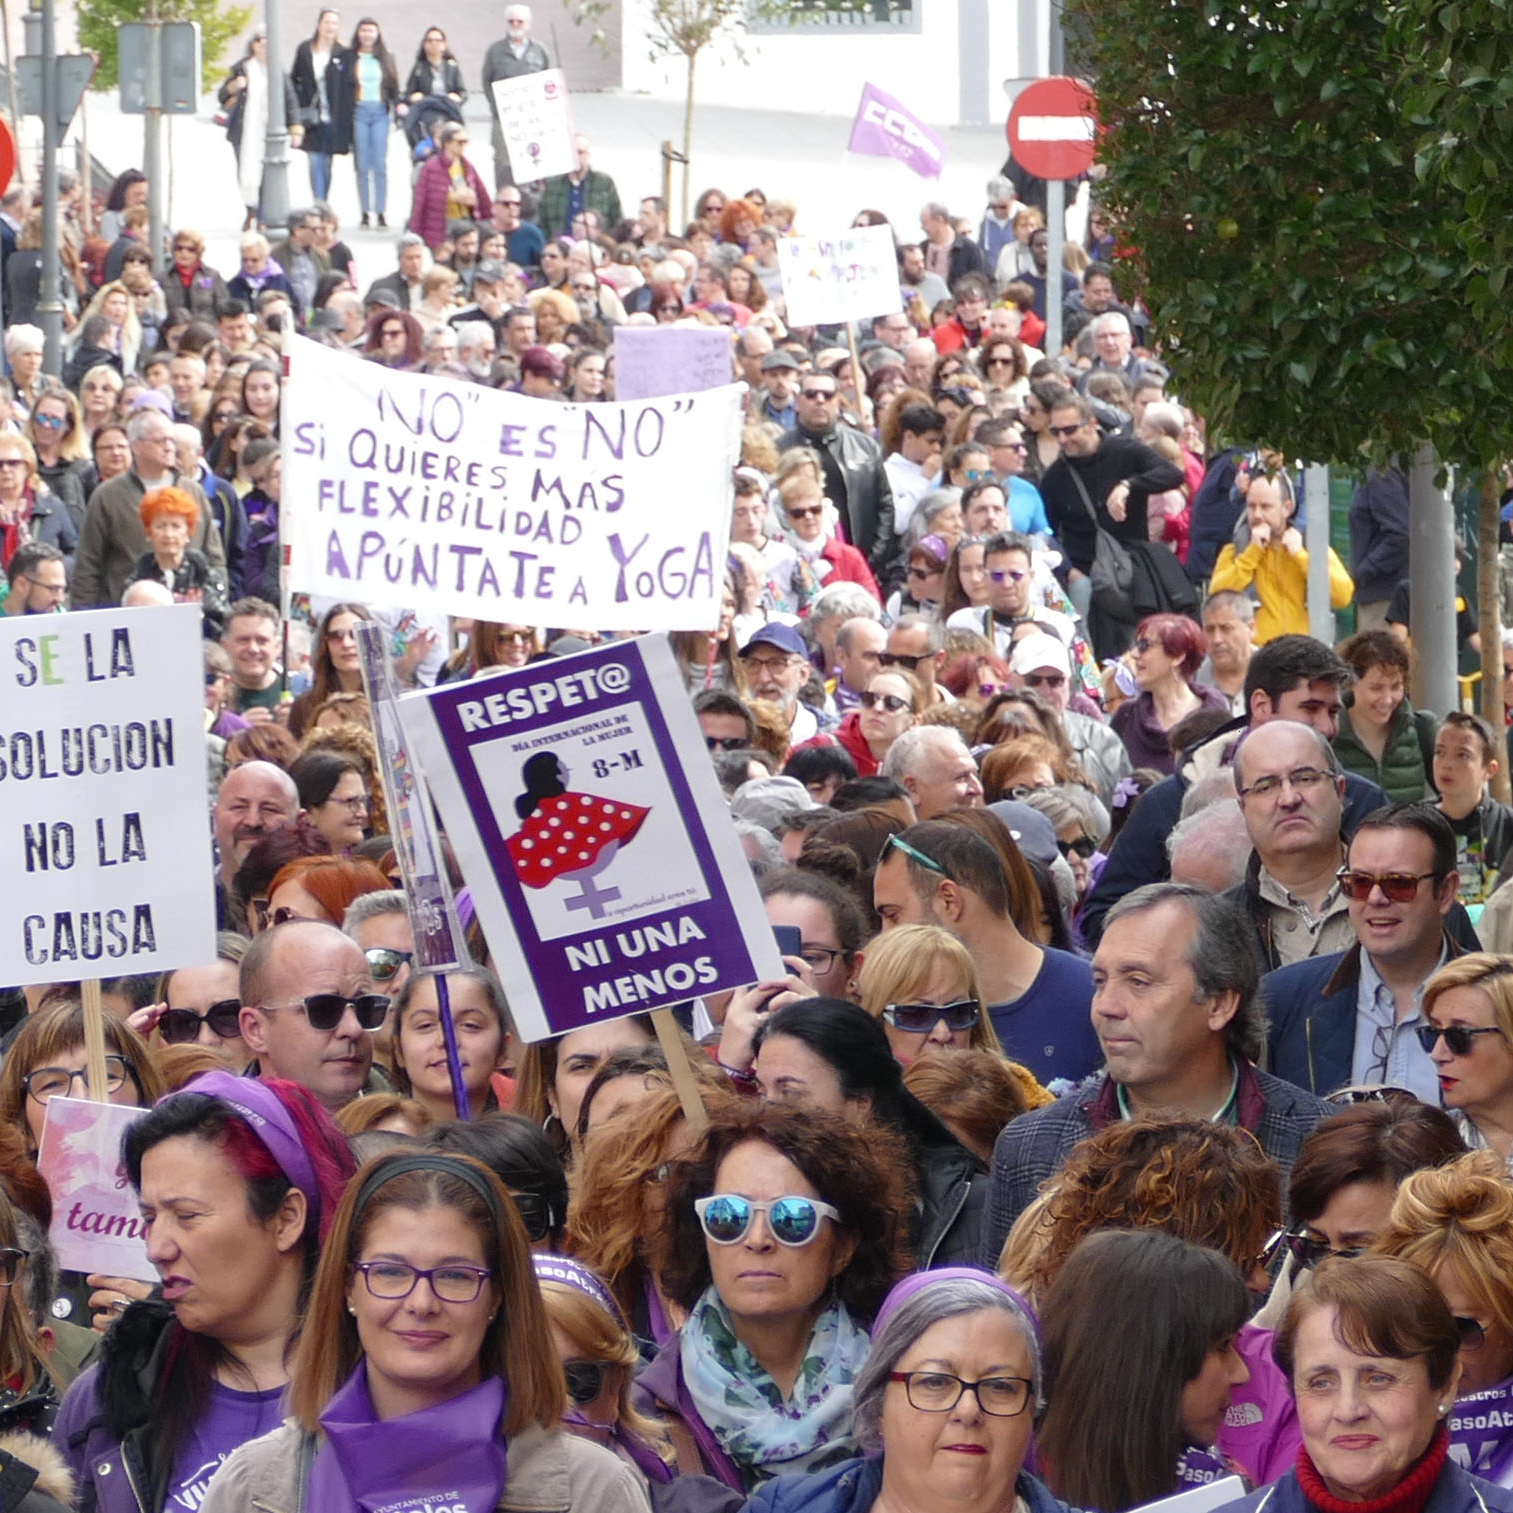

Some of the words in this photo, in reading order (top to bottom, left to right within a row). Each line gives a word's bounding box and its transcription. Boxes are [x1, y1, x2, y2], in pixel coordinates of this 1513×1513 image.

[498, 424, 557, 459] ES
[568, 576, 588, 606] A
[15, 634, 64, 687] SE
[84, 627, 135, 682] LA
[456, 662, 632, 733] RESPET@
[531, 718, 613, 748] INTERNACIONAL
[613, 714, 629, 724] DE
[582, 735, 597, 746] LA
[597, 726, 634, 741] MUJER
[591, 748, 645, 779] 8-M
[23, 821, 74, 873] NO
[96, 812, 147, 867] LA
[23, 904, 157, 965] CAUSA
[564, 938, 609, 972] NI
[617, 916, 706, 960] UNA
[582, 957, 718, 1013] MENOS
[447, 1491, 459, 1500] DE
